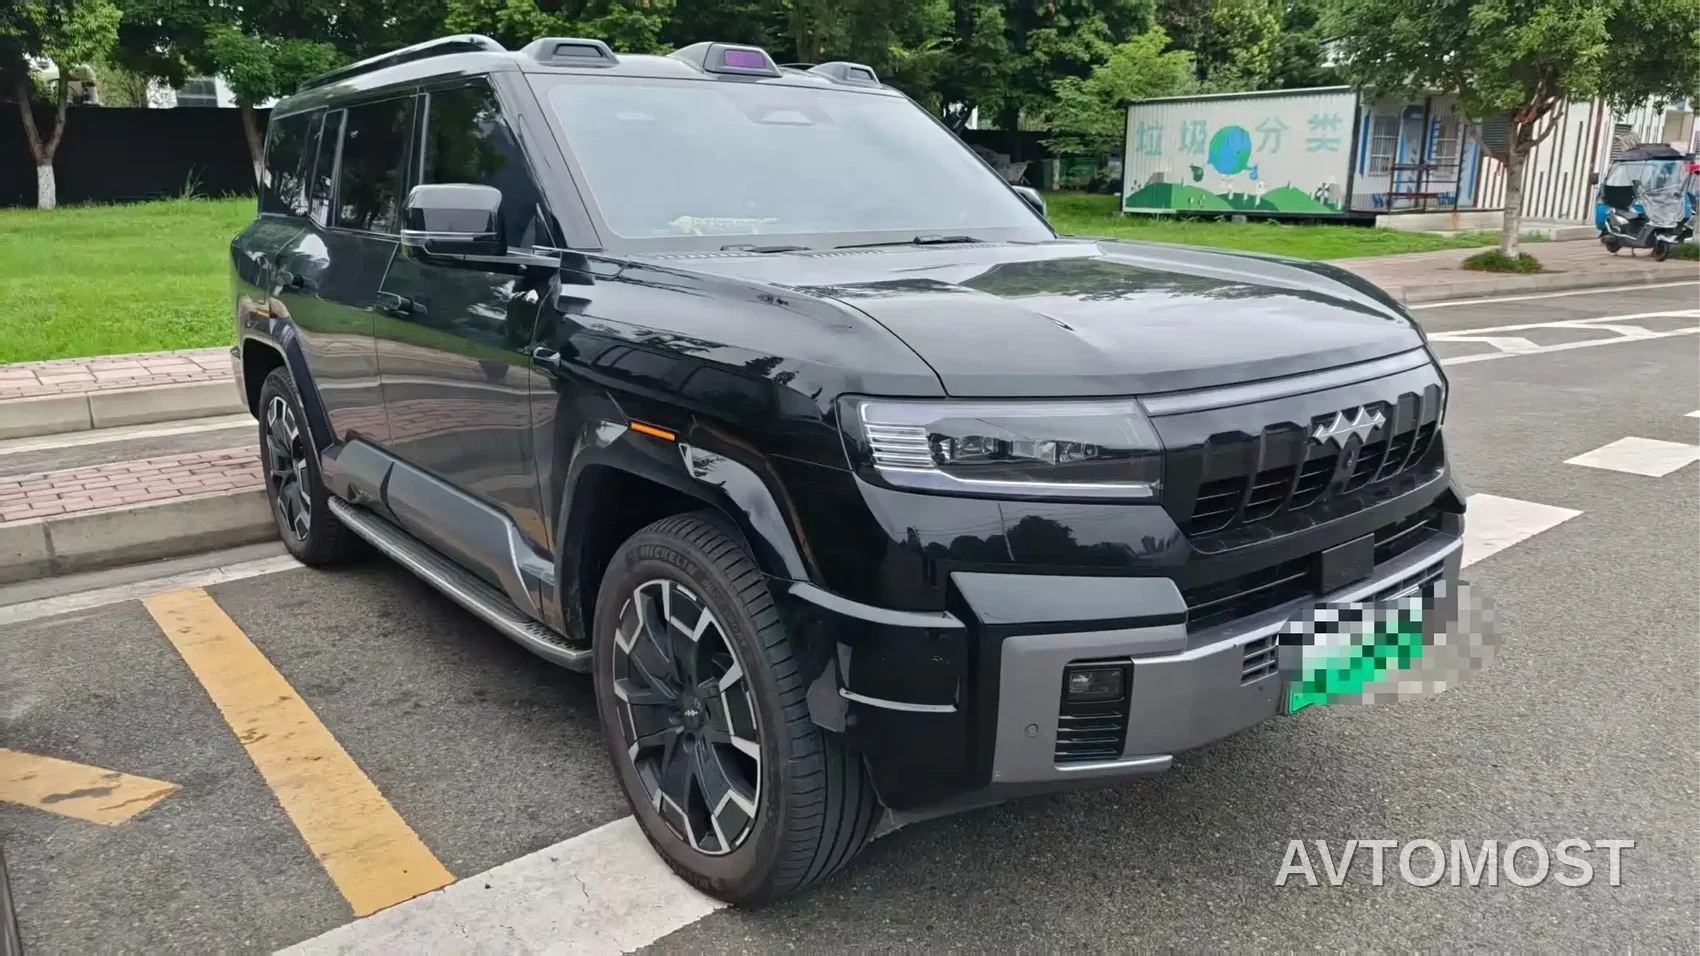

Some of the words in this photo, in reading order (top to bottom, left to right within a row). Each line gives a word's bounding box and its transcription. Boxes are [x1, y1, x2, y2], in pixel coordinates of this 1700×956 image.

[1136, 112, 1343, 157] 垃圾分类
[640, 545, 699, 576] MICHELIN
